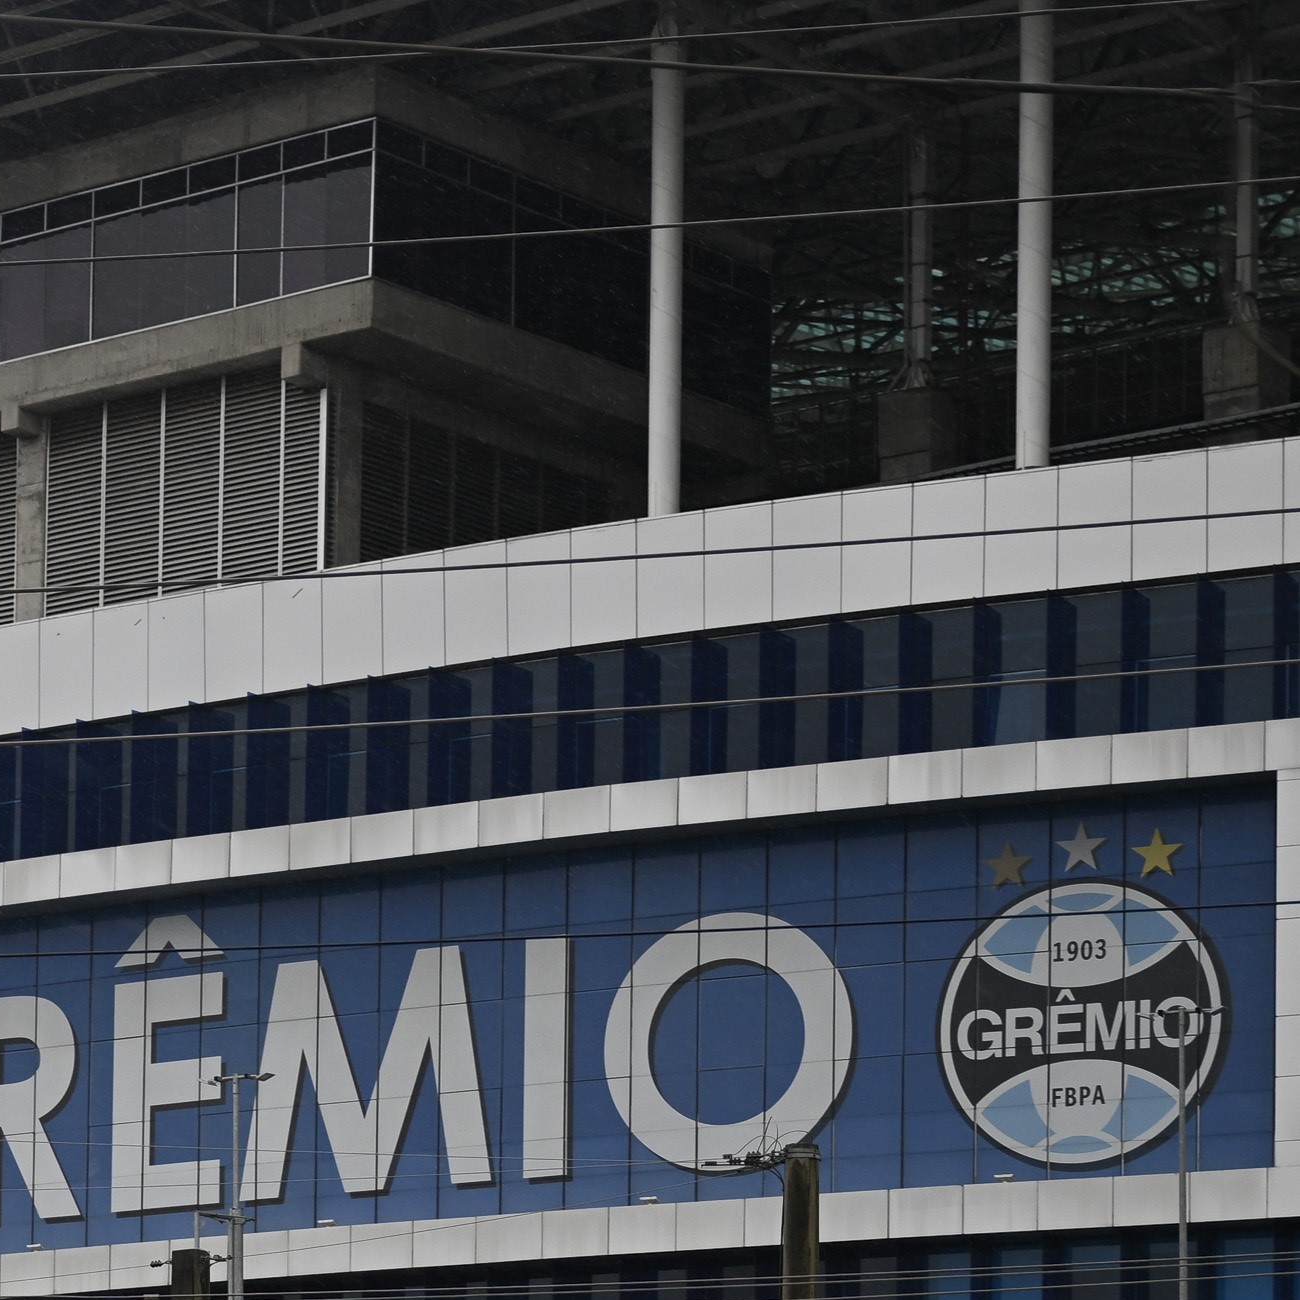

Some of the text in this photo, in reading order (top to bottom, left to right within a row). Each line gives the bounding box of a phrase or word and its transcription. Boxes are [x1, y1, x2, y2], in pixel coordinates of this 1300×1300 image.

[1052, 938, 1108, 962] 1903
[957, 988, 1205, 1061] GRÊMIO
[1051, 1084, 1106, 1108] FBPA
